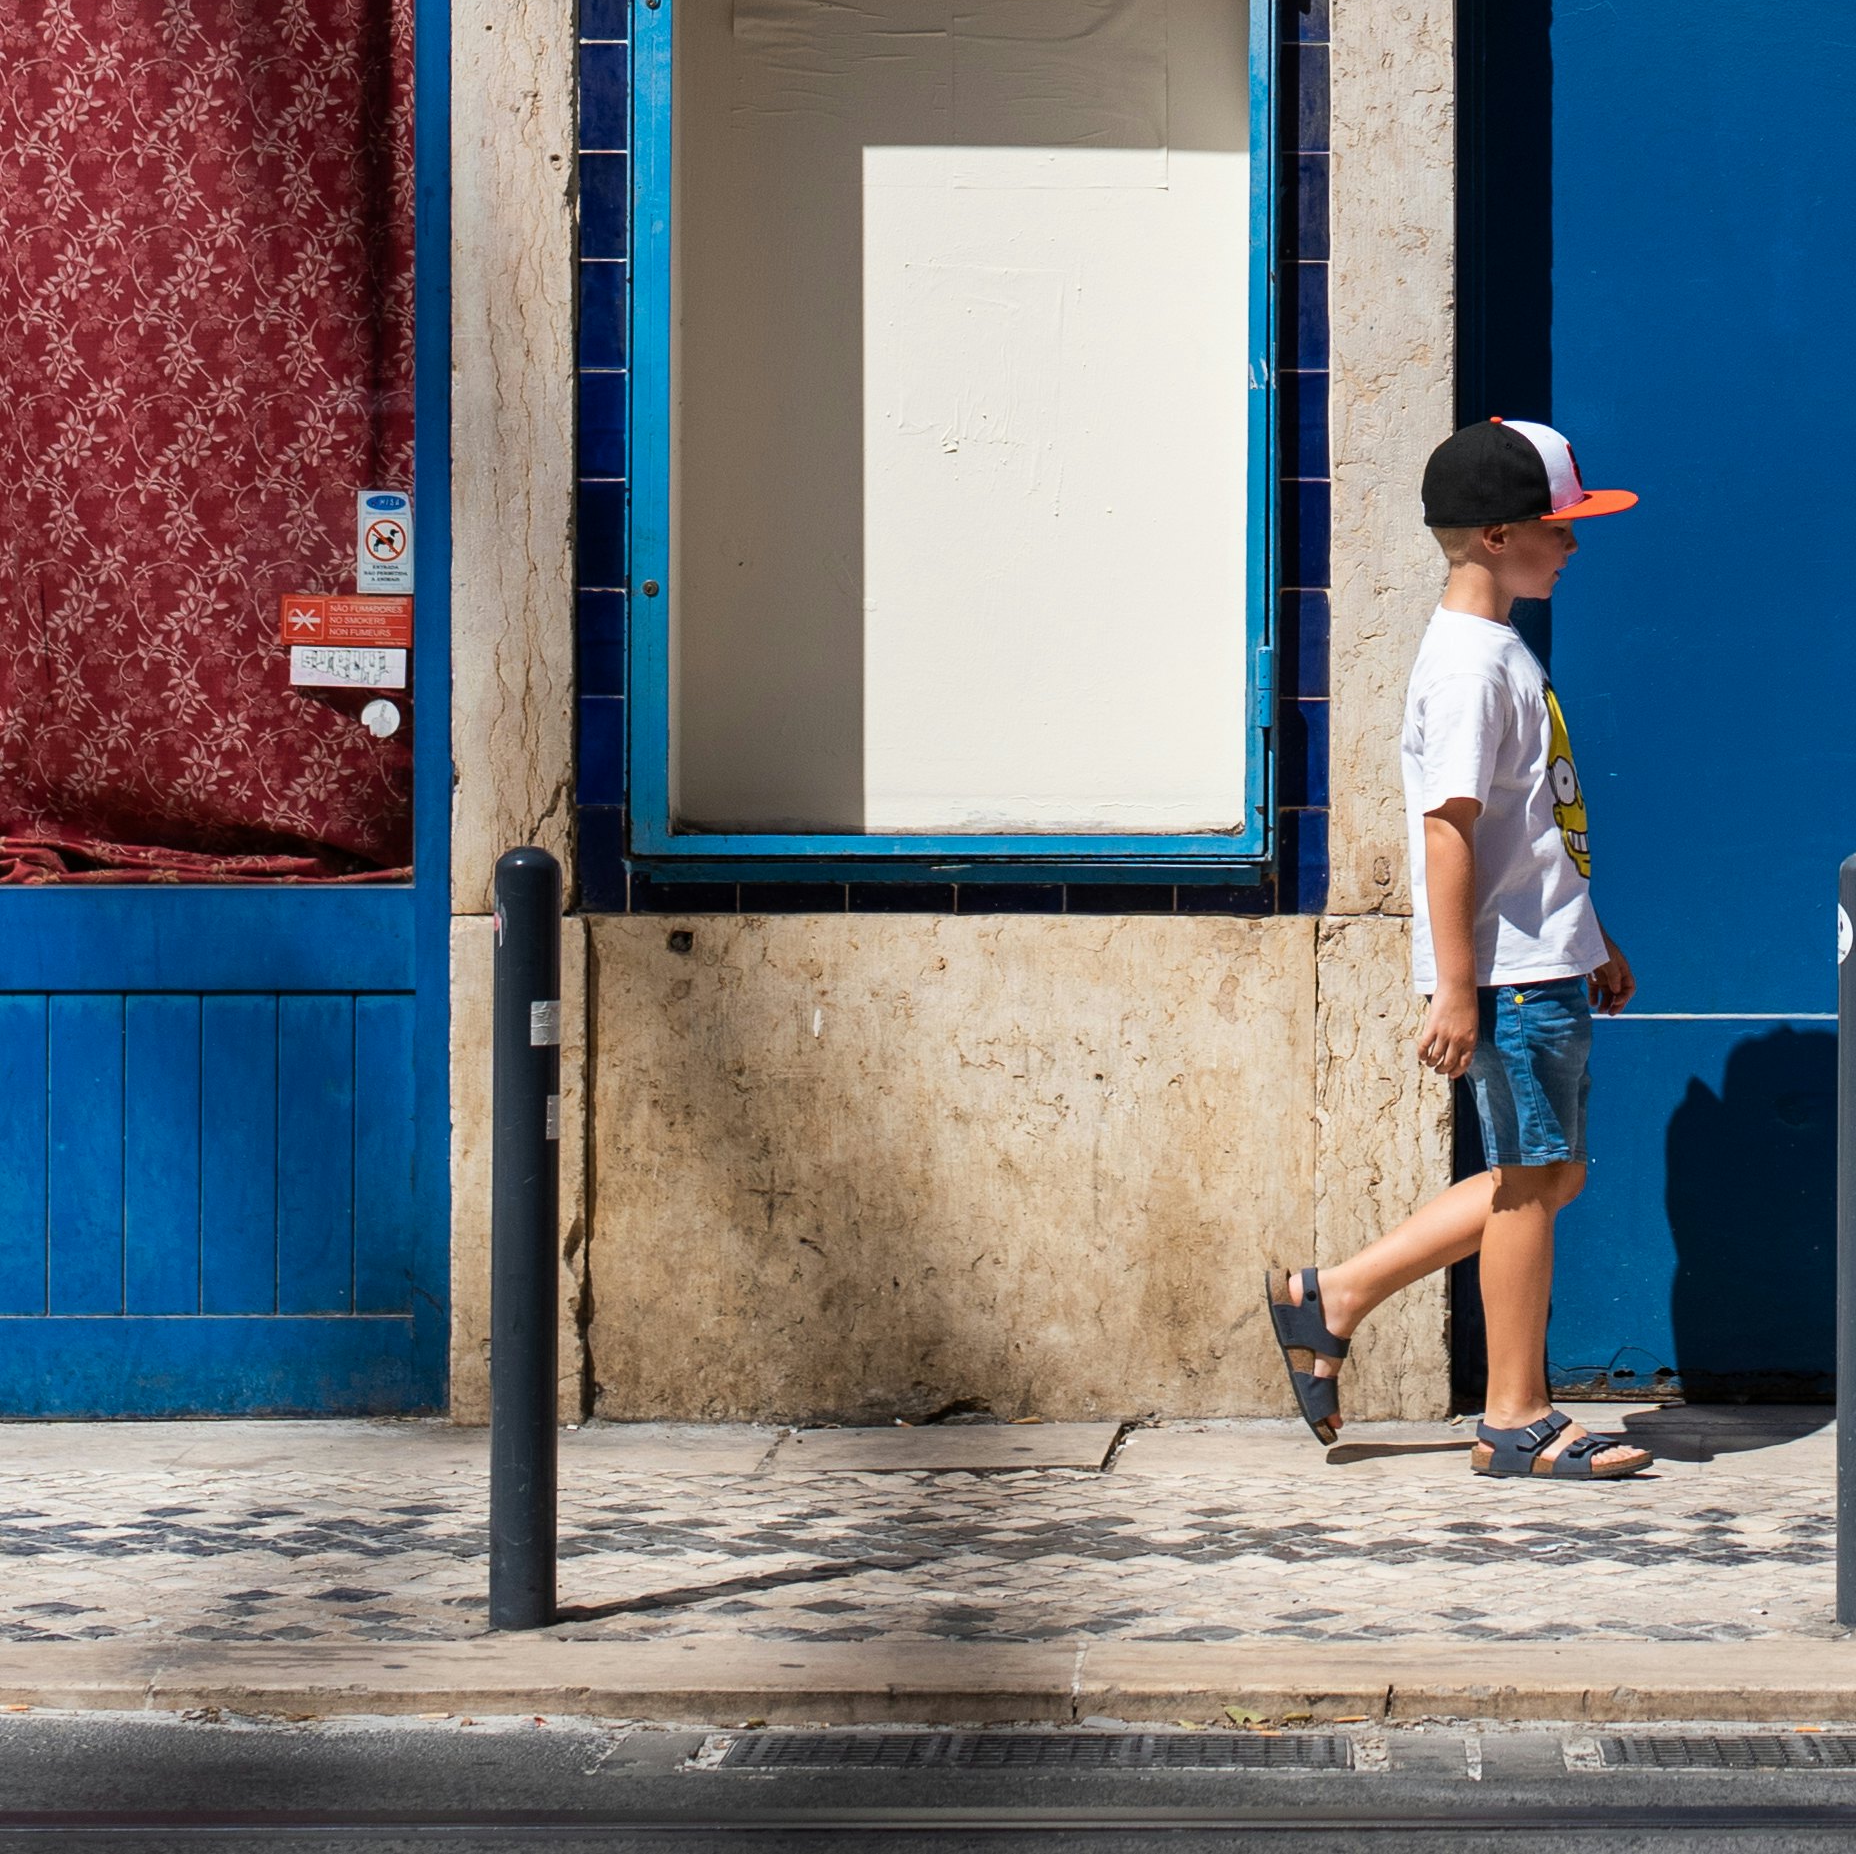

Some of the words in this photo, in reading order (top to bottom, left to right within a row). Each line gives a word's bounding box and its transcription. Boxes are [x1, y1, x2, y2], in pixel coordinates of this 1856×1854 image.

[329, 604, 348, 613] NÃO
[350, 605, 403, 614] FUMADORES
[329, 616, 342, 624] NO
[344, 617, 386, 625] SMOKERS
[329, 628, 348, 636] NON
[350, 628, 391, 637] FUMEURS
